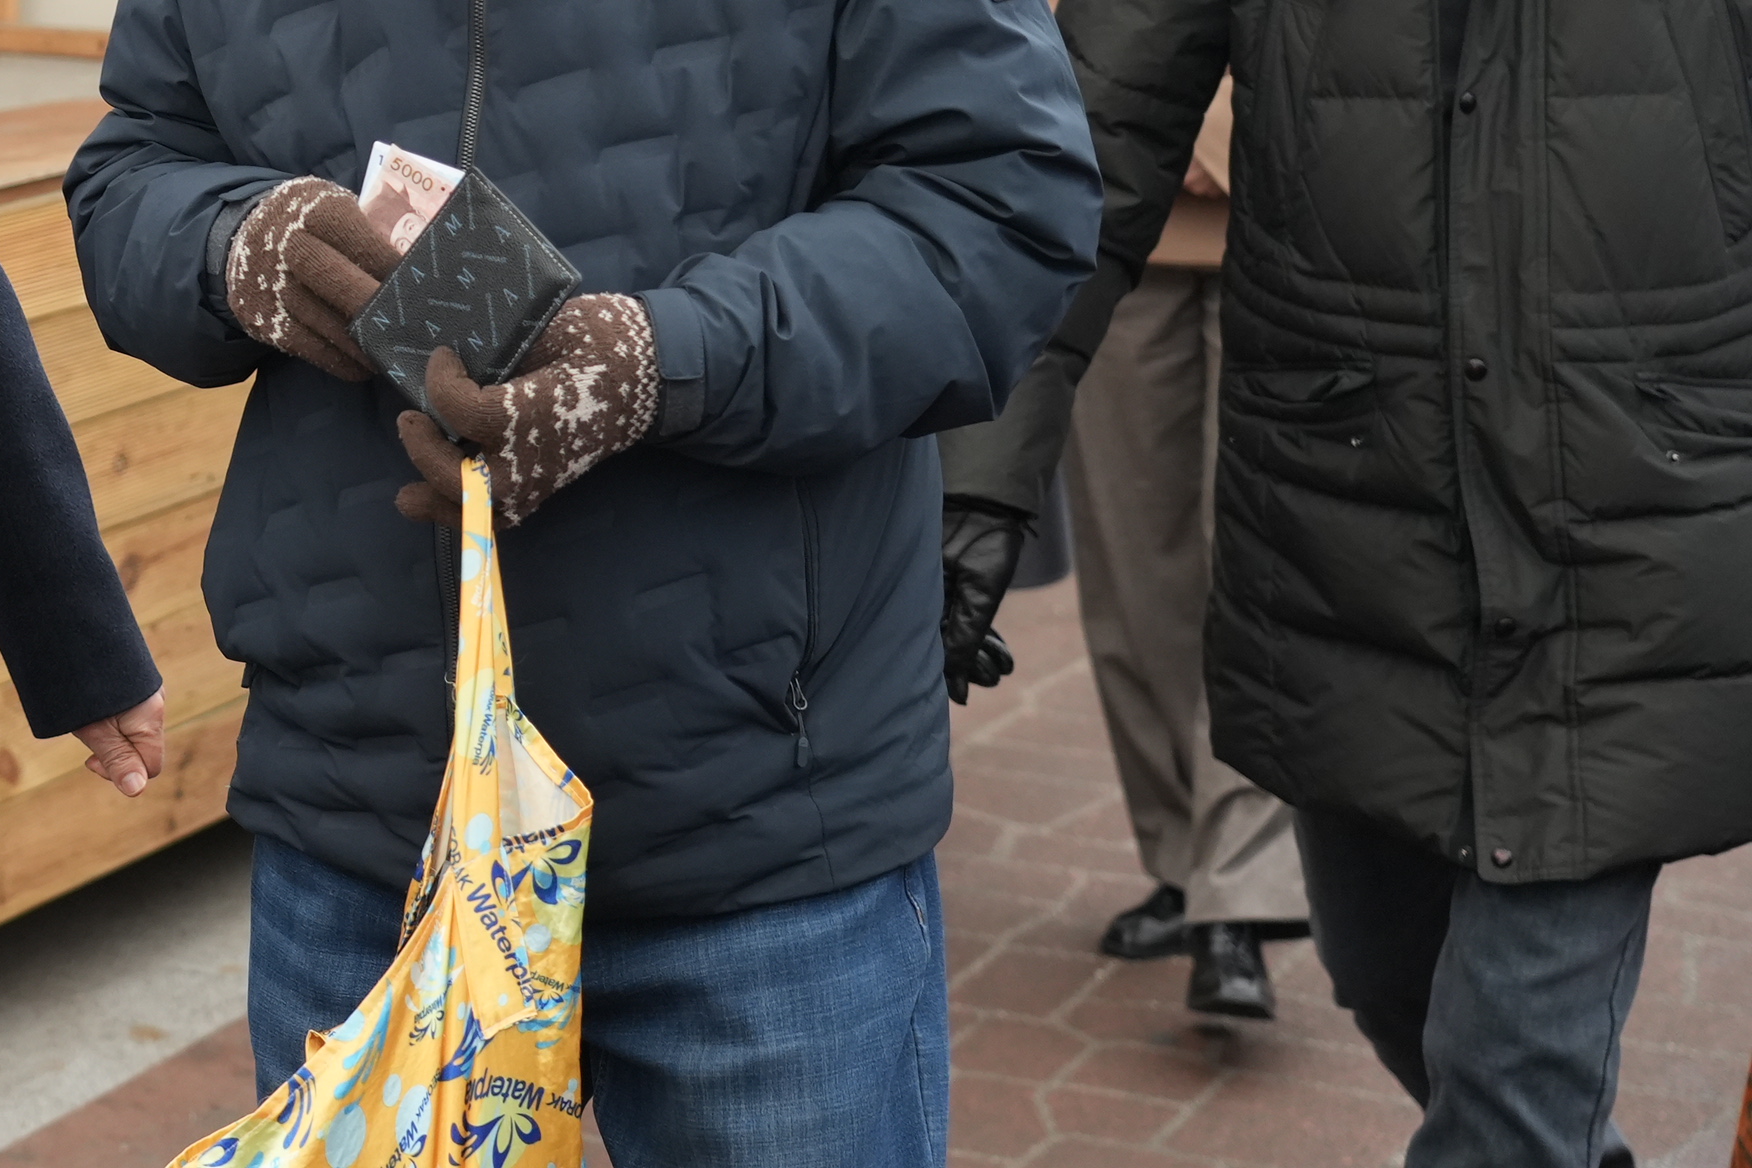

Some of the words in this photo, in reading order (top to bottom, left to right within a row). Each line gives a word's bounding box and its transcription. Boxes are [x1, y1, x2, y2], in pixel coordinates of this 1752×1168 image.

[389, 157, 435, 193] 5000
[472, 713, 495, 766] Waterpia
[467, 883, 535, 1003] Waterpia
[530, 970, 565, 993] Waterp
[465, 1067, 546, 1112] Waterpia
[546, 1092, 583, 1119] ORAK
